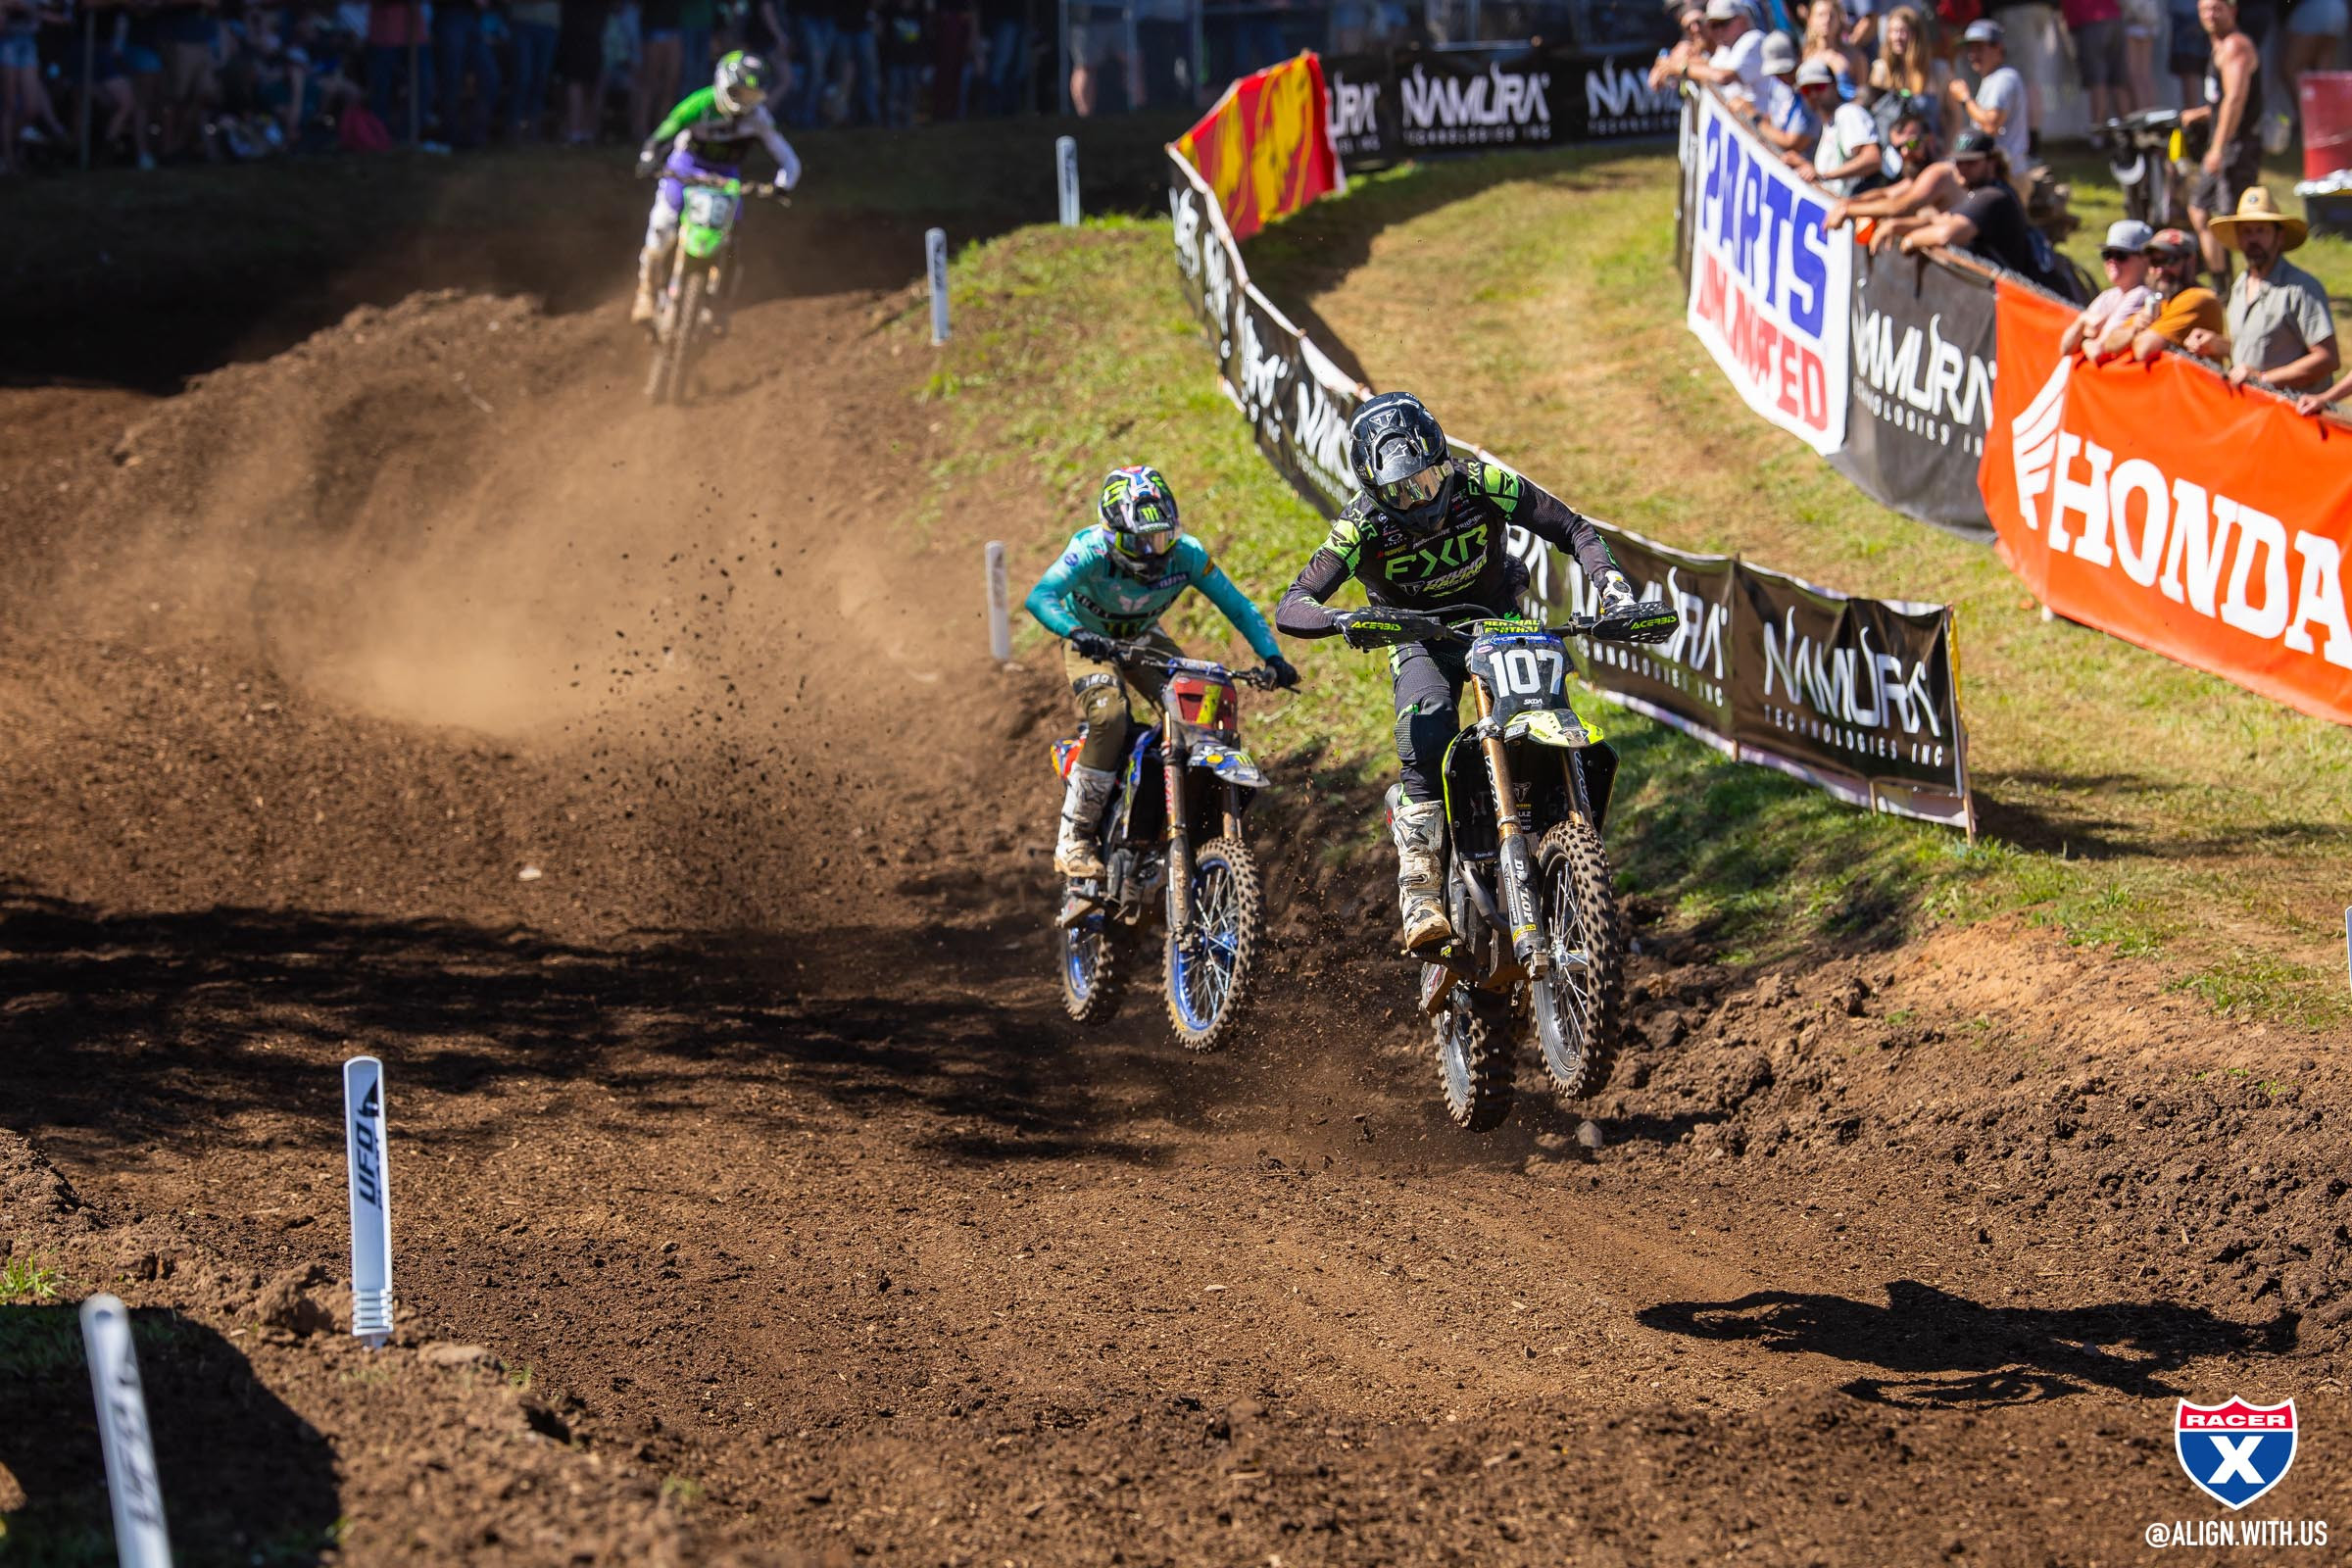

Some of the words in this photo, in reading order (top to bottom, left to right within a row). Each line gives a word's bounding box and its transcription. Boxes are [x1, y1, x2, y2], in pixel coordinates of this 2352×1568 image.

[1401, 61, 1550, 129] NAMURA
[1703, 113, 1829, 340] PARTS
[1385, 523, 1488, 581] FXR
[2048, 430, 2352, 670] HONDA
[1350, 620, 1402, 632] ACERBIS
[1630, 614, 1678, 631] ACERBIS
[1489, 649, 1564, 699] 107
[1764, 605, 1941, 737] NAMURA
[1765, 704, 1898, 760] TECHNOLOGIES
[1912, 742, 1944, 767] INC
[1514, 859, 1534, 923] DLOP
[356, 1120, 376, 1205] UFO
